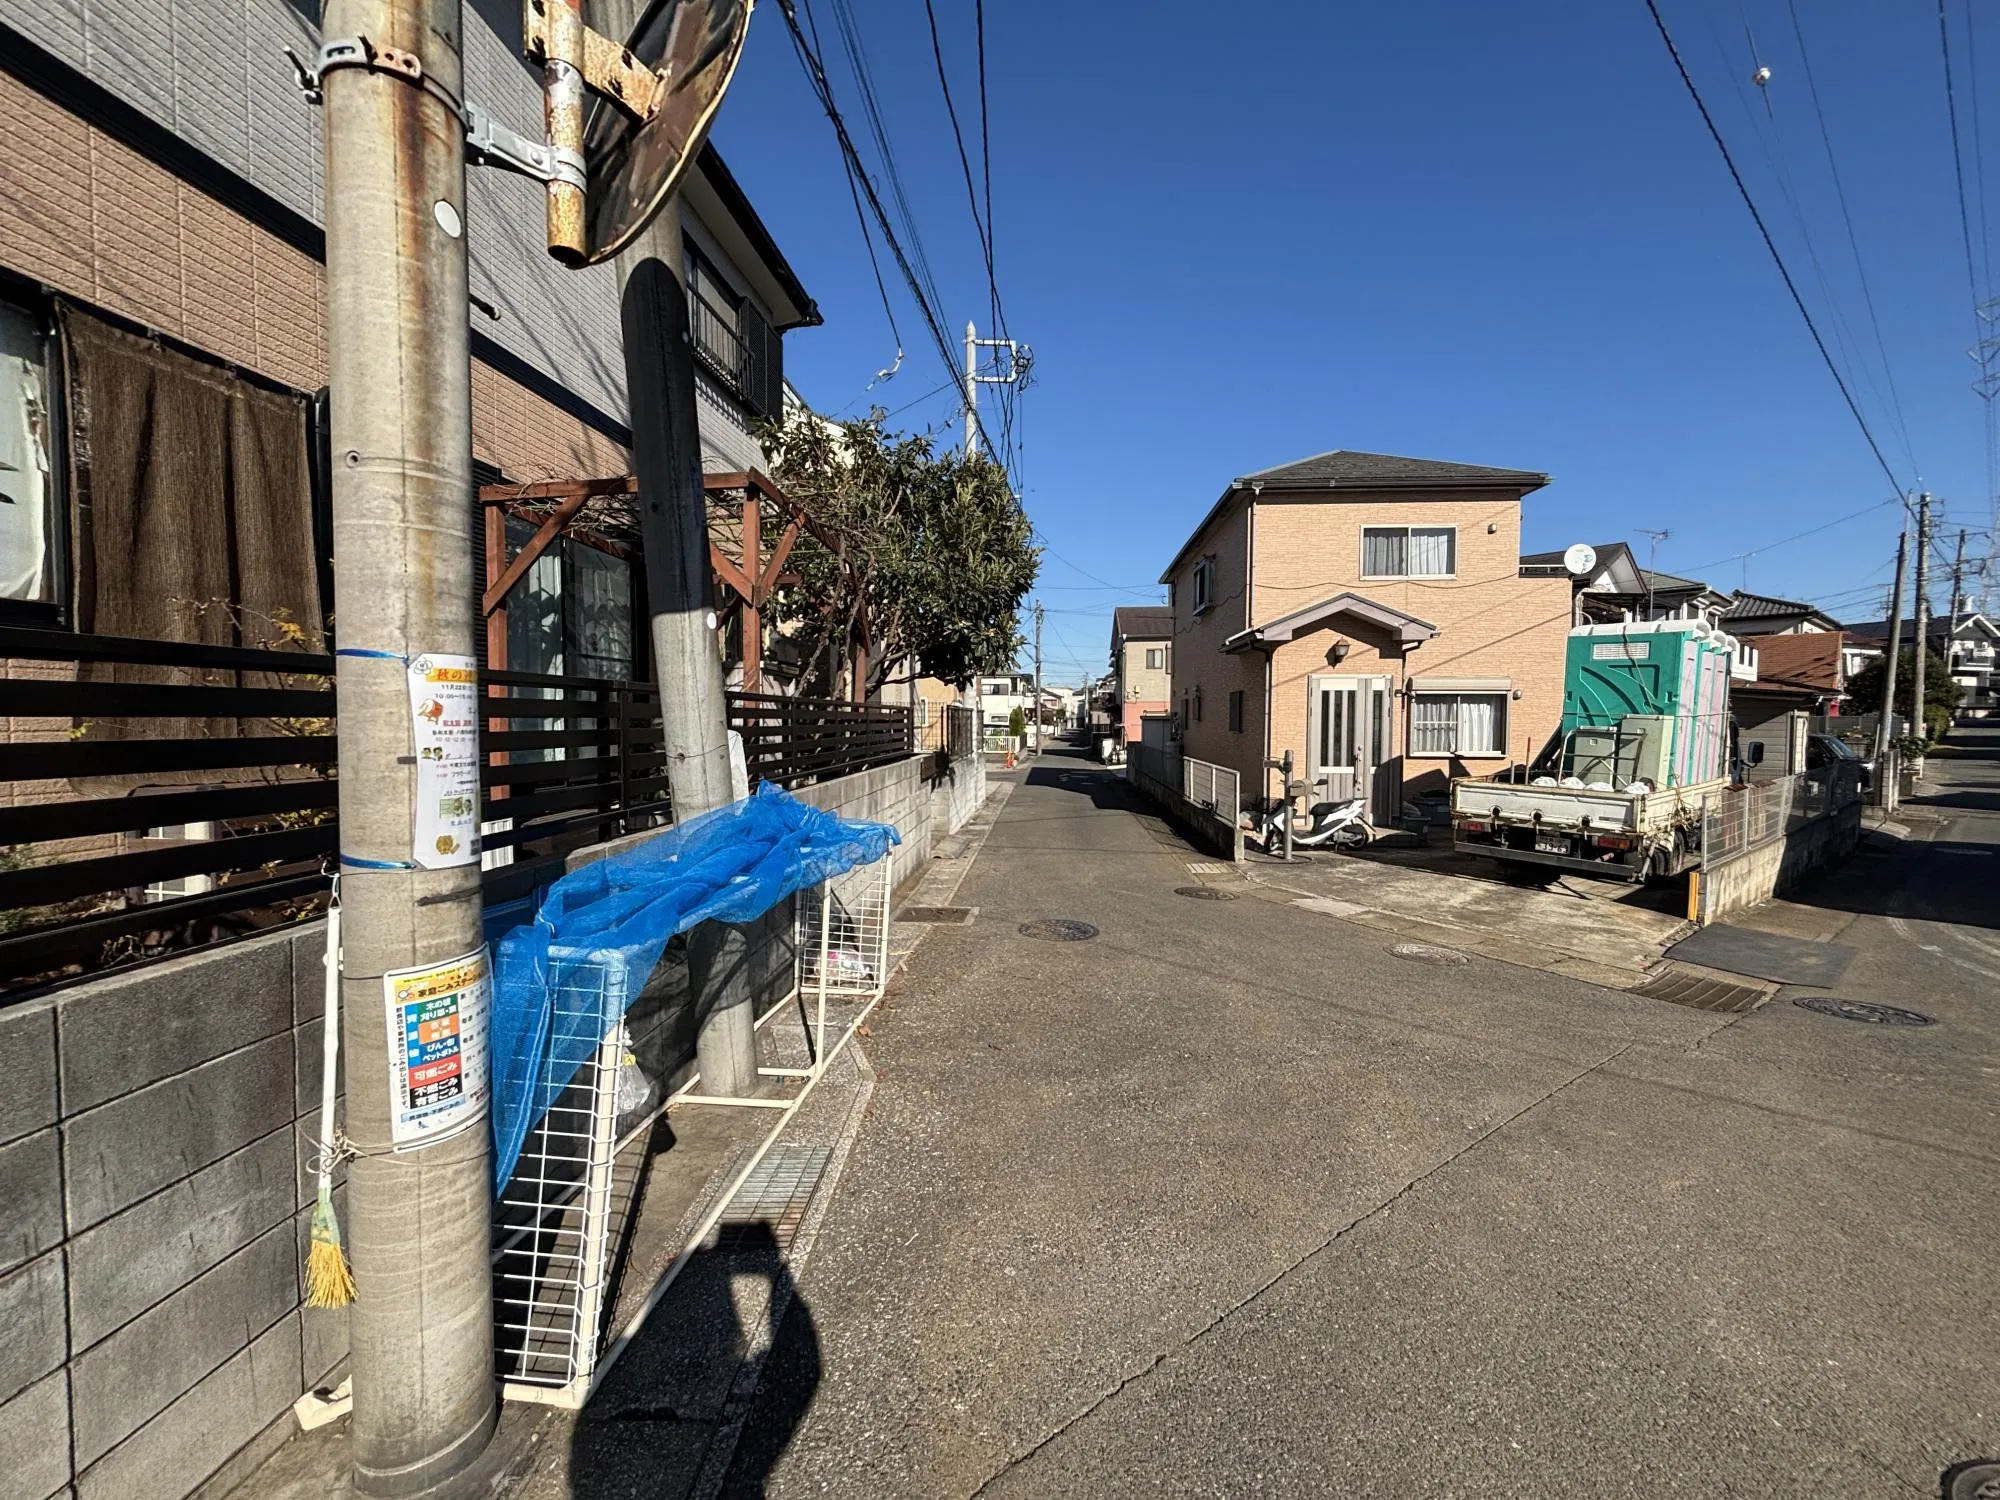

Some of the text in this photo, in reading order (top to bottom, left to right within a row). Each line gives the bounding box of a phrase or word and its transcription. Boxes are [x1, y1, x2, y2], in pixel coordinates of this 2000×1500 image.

[423, 1046, 460, 1061] ペットボトル
[414, 1062, 457, 1080] 可燃ごみ
[414, 1077, 458, 1096] 不燃ごみ
[415, 1087, 459, 1107] 有害ごみ
